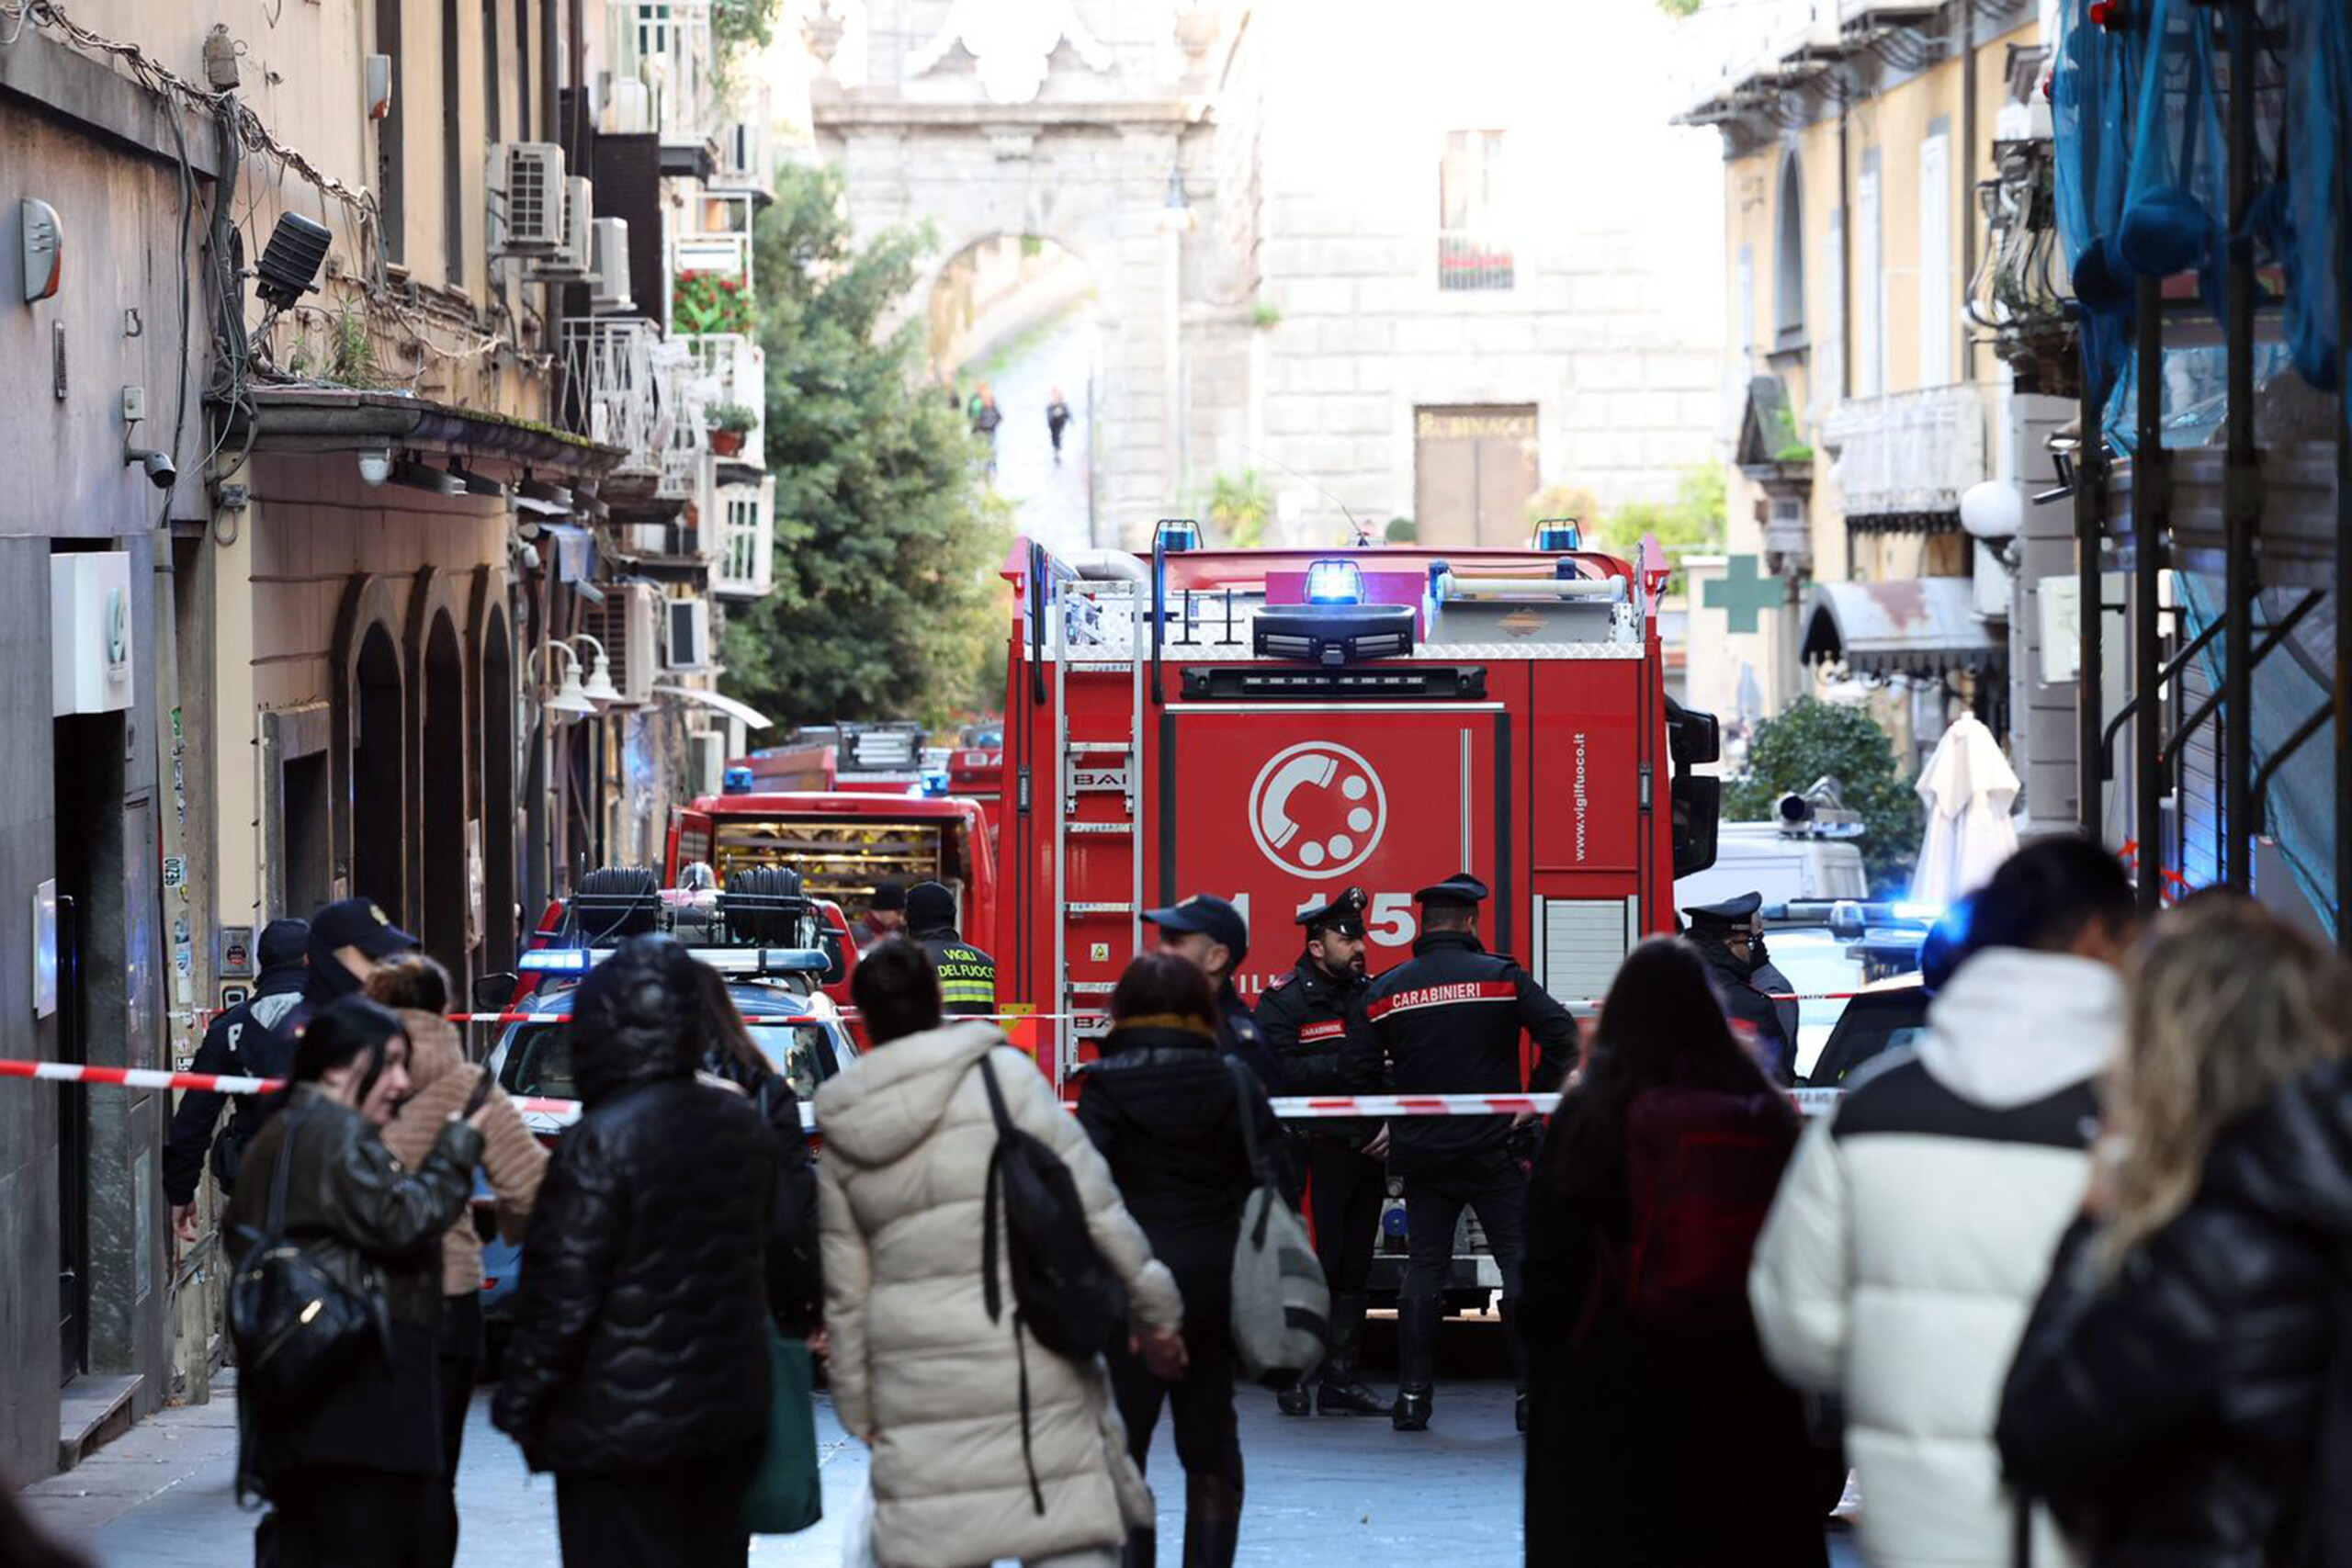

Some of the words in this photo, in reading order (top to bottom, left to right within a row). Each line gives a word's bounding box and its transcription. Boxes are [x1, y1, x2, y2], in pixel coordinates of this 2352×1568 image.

[1073, 773, 1126, 785] BAI
[1573, 733, 1588, 862] www.vigilfuoco.it
[938, 964, 961, 977] DEL
[1393, 983, 1481, 1009] CARABINIERI
